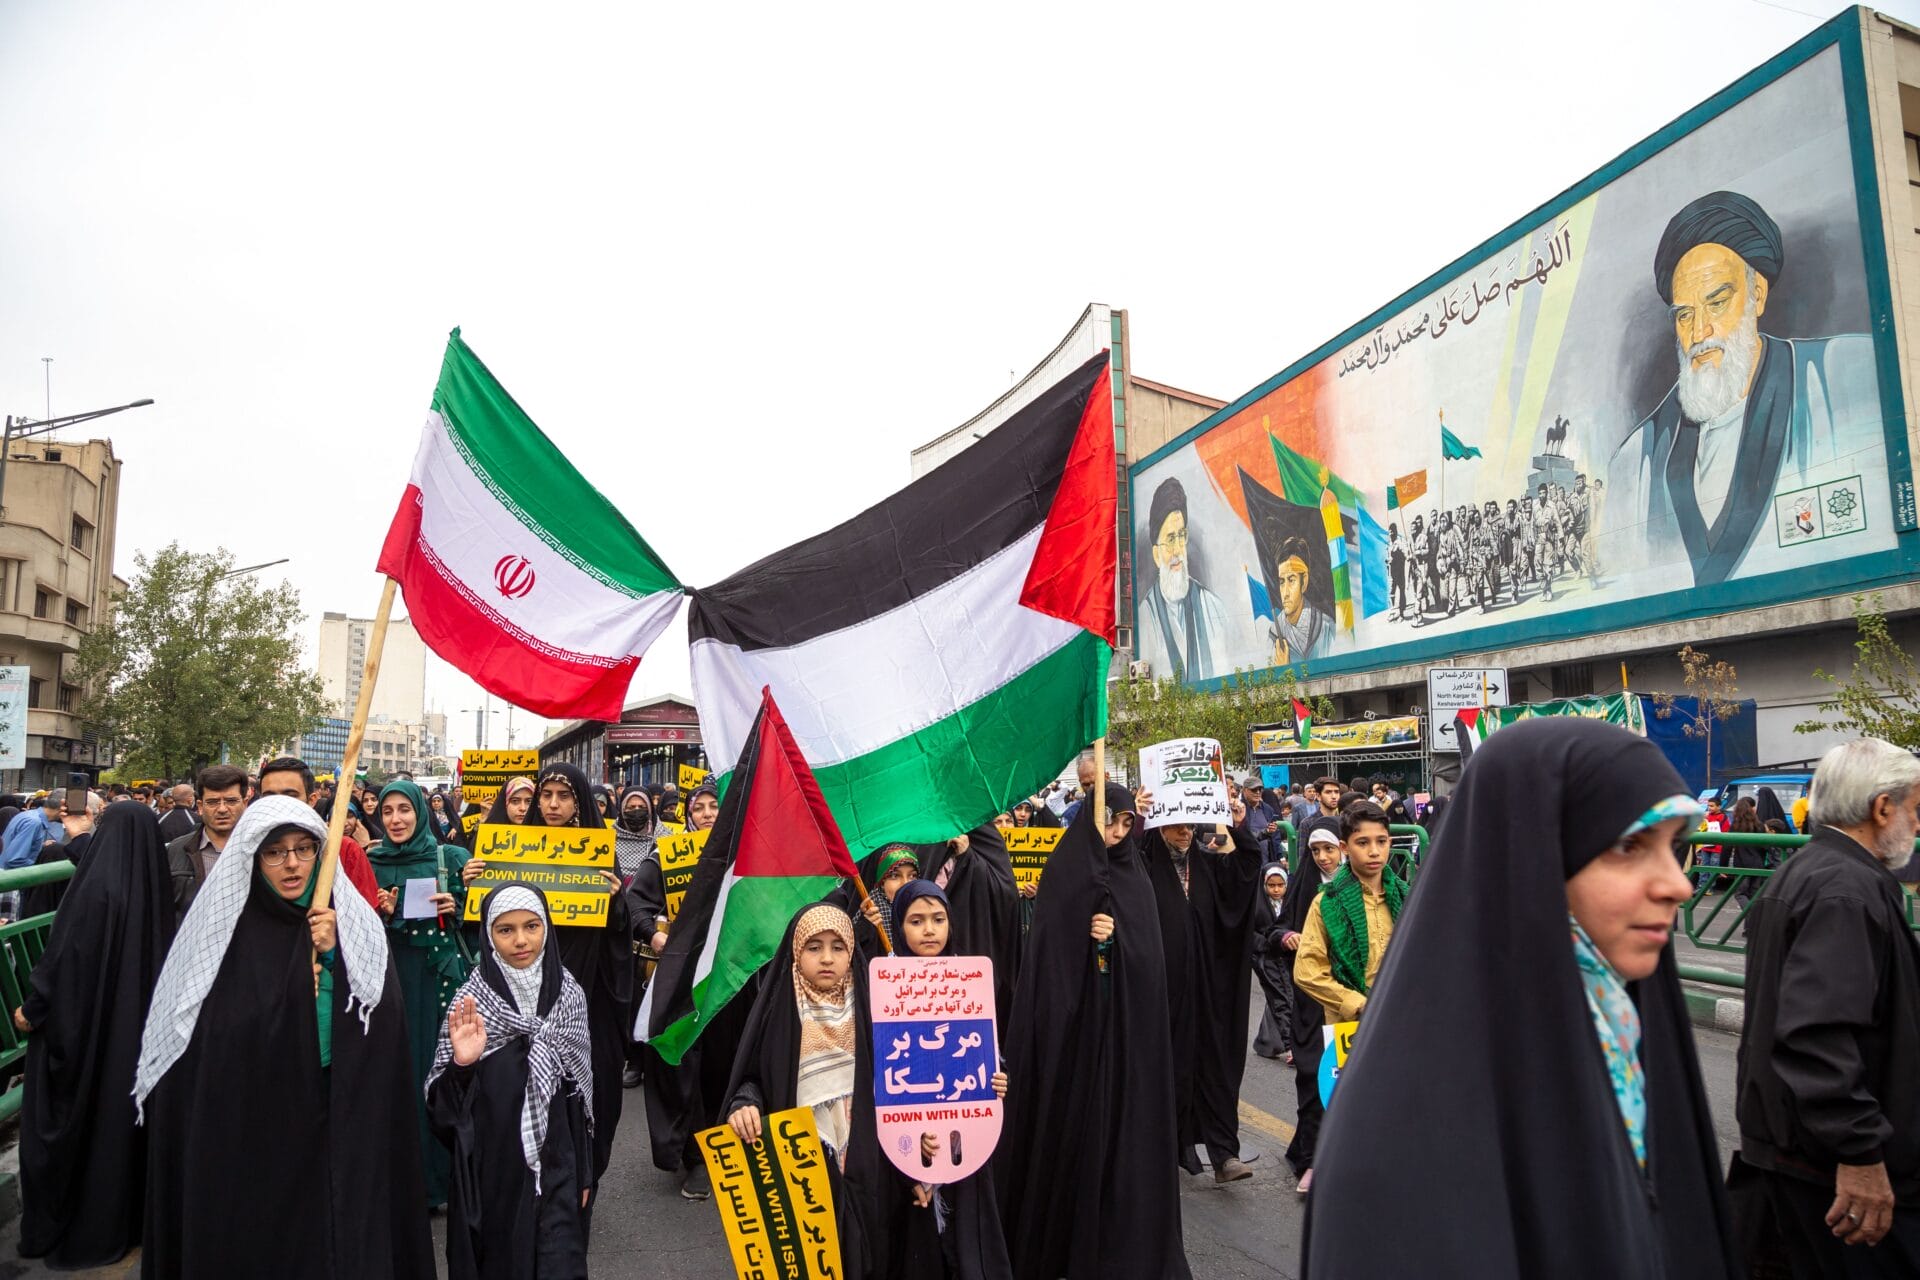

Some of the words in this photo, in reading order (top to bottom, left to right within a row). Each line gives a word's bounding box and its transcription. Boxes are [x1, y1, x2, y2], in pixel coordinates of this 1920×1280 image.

[1436, 671, 1457, 680] شمالی
[1457, 671, 1474, 680] کارگر
[1452, 682, 1474, 691] کشاورز
[465, 753, 499, 769] اسرائیل
[500, 757, 510, 769] بر
[511, 755, 536, 768] مرگ
[1183, 786, 1214, 796] شکست
[1148, 801, 1183, 819] اسرائیل
[1186, 801, 1210, 815] ترمیم
[481, 830, 547, 857] اسرائیل
[1031, 835, 1042, 848] بر
[547, 840, 566, 859] بر
[568, 837, 610, 861] مرگ
[1015, 856, 1038, 864] WITH
[521, 871, 555, 883] WITH
[559, 874, 609, 886] ISRAEL
[667, 873, 693, 886] DOW
[549, 898, 607, 920] الموت
[877, 968, 906, 983] آمریکا
[909, 972, 917, 983] بر
[918, 969, 939, 982] مرگ
[941, 968, 960, 982] شعار
[960, 969, 983, 981] همین
[895, 985, 928, 999] اسرائیل
[929, 987, 937, 999] بر
[938, 986, 960, 998] مرگ
[961, 988, 967, 998] و
[883, 1001, 905, 1017] آورد
[907, 1006, 921, 1016] می
[922, 1002, 944, 1015] مرگ
[944, 999, 961, 1014] آنها
[962, 1001, 983, 1014] برای
[885, 1031, 911, 1060] بر
[918, 1022, 982, 1058] مرگ
[884, 1062, 987, 1101] امریکا
[883, 1111, 922, 1123] DOWN
[926, 1109, 959, 1121] WITH
[961, 1107, 993, 1119] U.S.A
[778, 1120, 828, 1214] اسرائیل
[803, 1219, 827, 1244] بر
[752, 1137, 775, 1185] OWN
[766, 1188, 791, 1240] WITH
[781, 1245, 800, 1280] ISR
